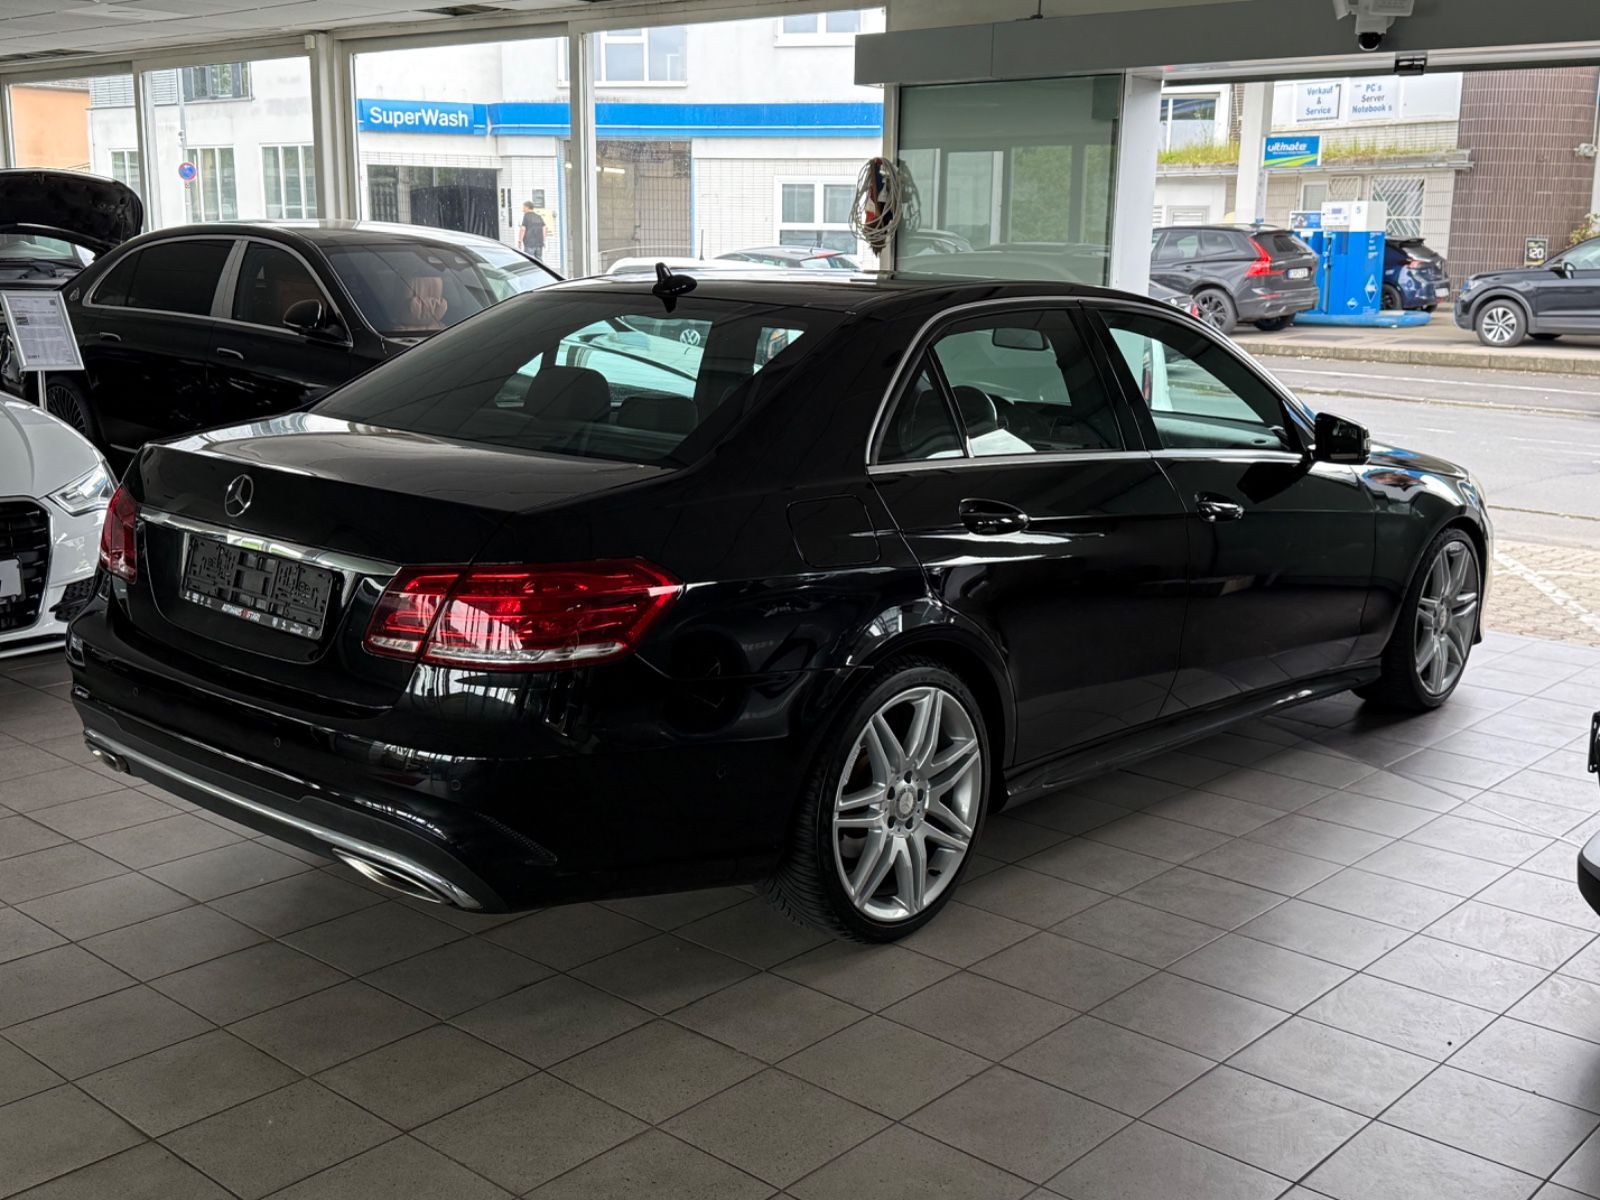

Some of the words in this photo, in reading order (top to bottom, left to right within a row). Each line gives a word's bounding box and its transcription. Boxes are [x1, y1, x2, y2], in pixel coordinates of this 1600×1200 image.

[1307, 86, 1333, 95] Verkauf
[1316, 96, 1322, 104] &
[1361, 94, 1385, 103] Server
[1305, 107, 1331, 116] Service
[369, 106, 468, 128] SuperWash
